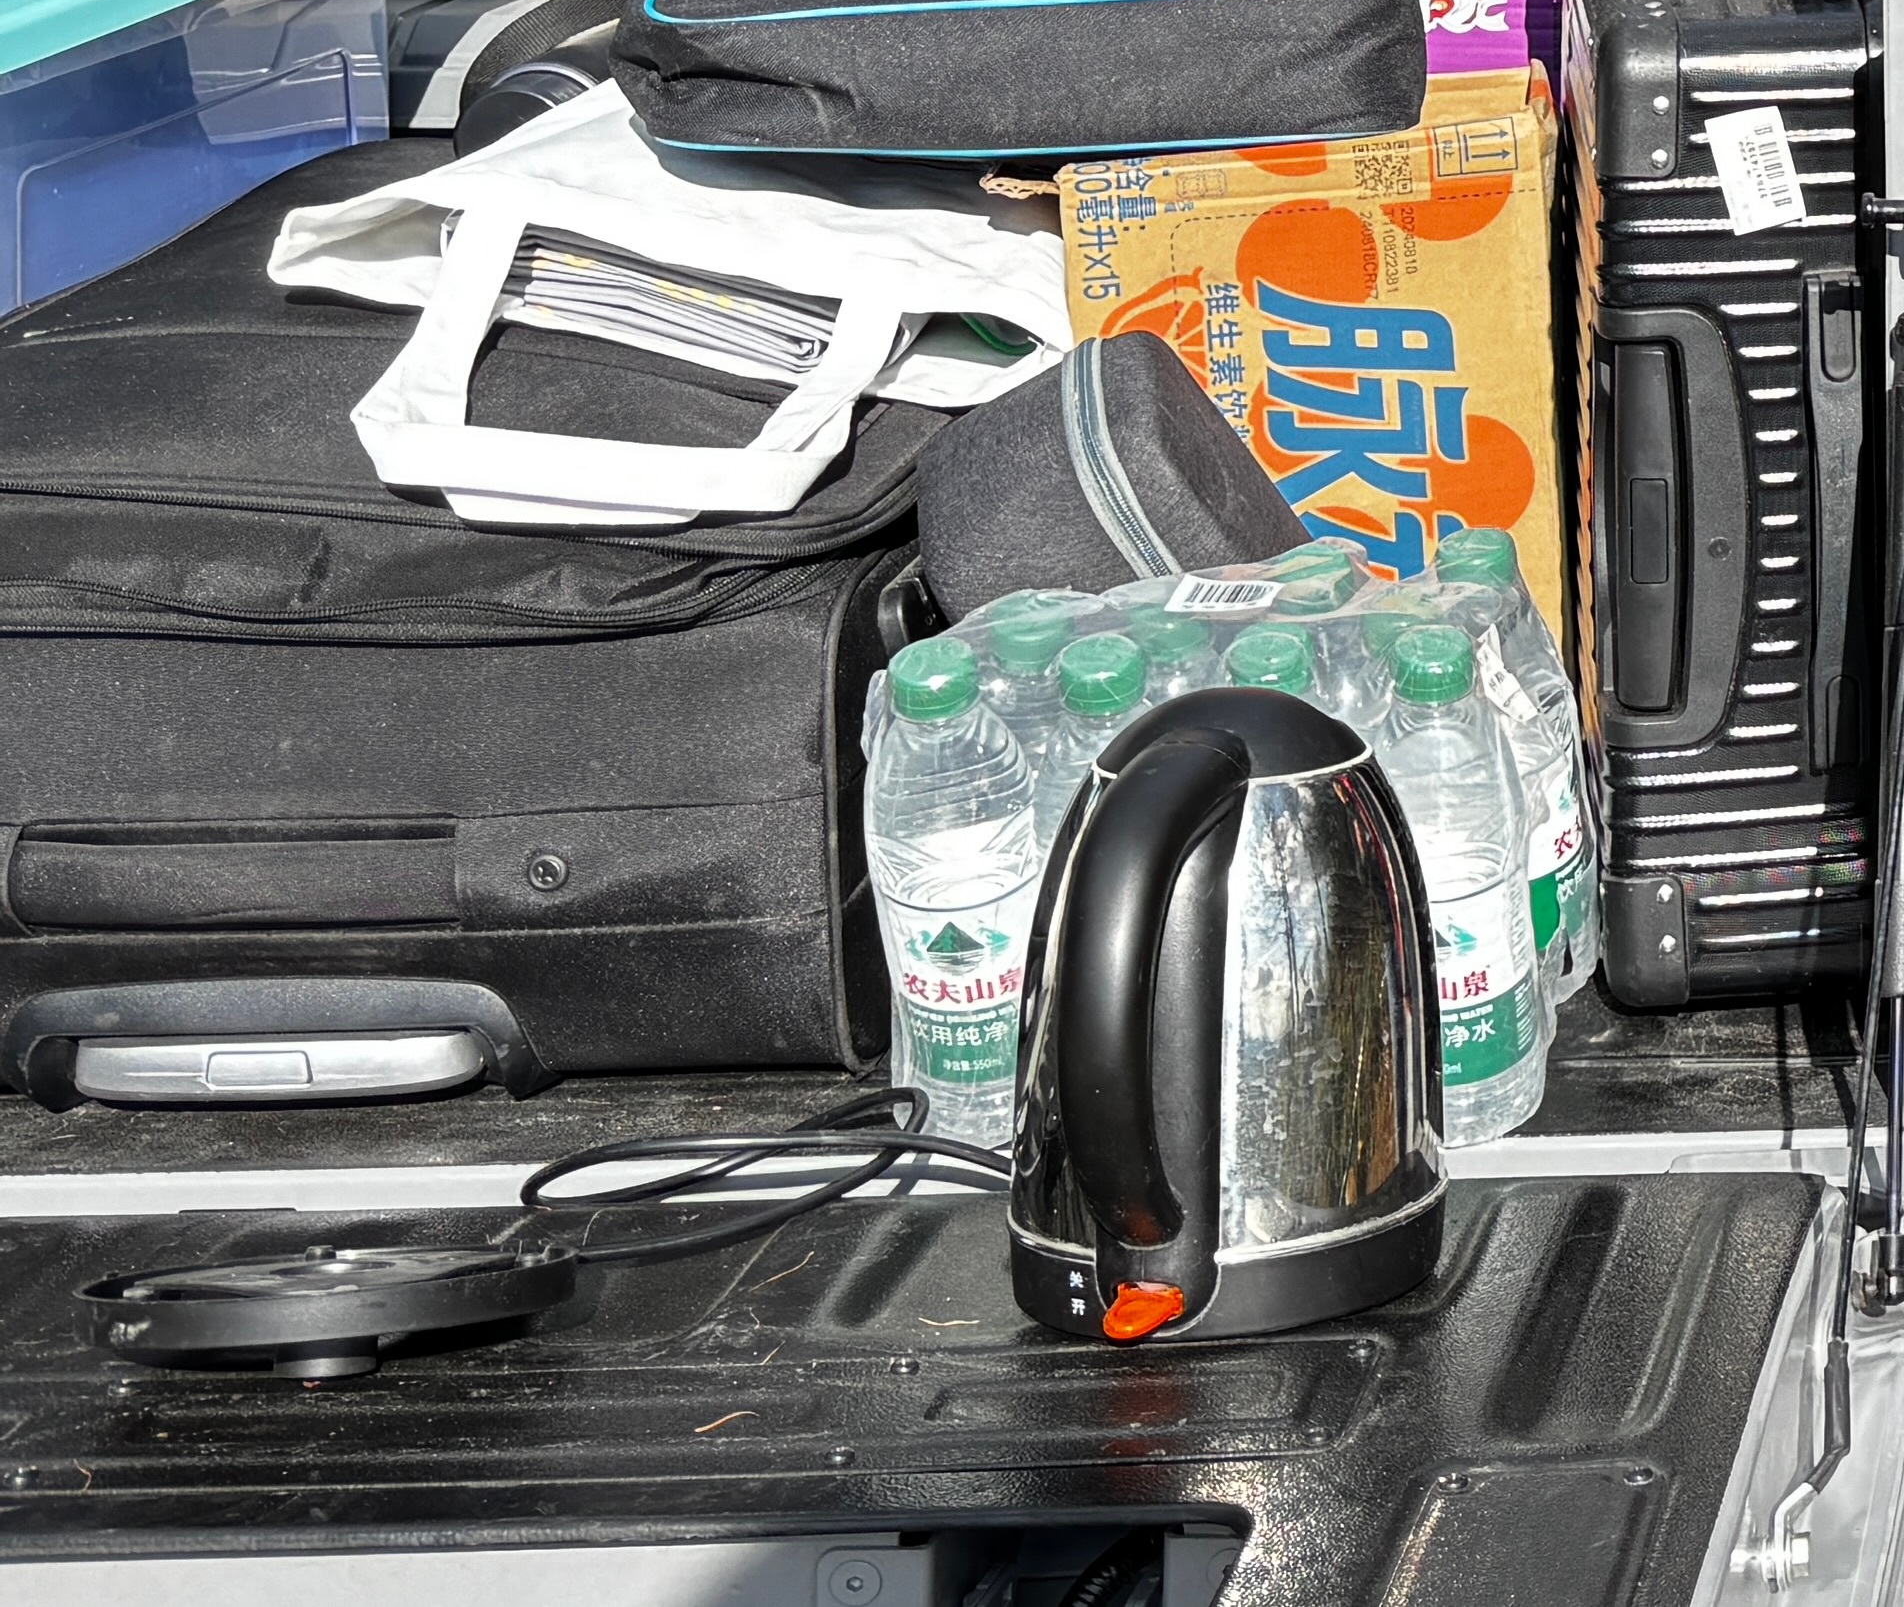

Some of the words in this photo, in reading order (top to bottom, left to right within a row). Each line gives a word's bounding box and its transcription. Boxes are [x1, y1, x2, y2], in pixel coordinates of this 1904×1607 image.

[911, 1017, 1018, 1047] 饮用纯净
[1444, 1018, 1496, 1049] 净水
[1069, 1270, 1085, 1289] 关
[1070, 1297, 1087, 1316] 开
